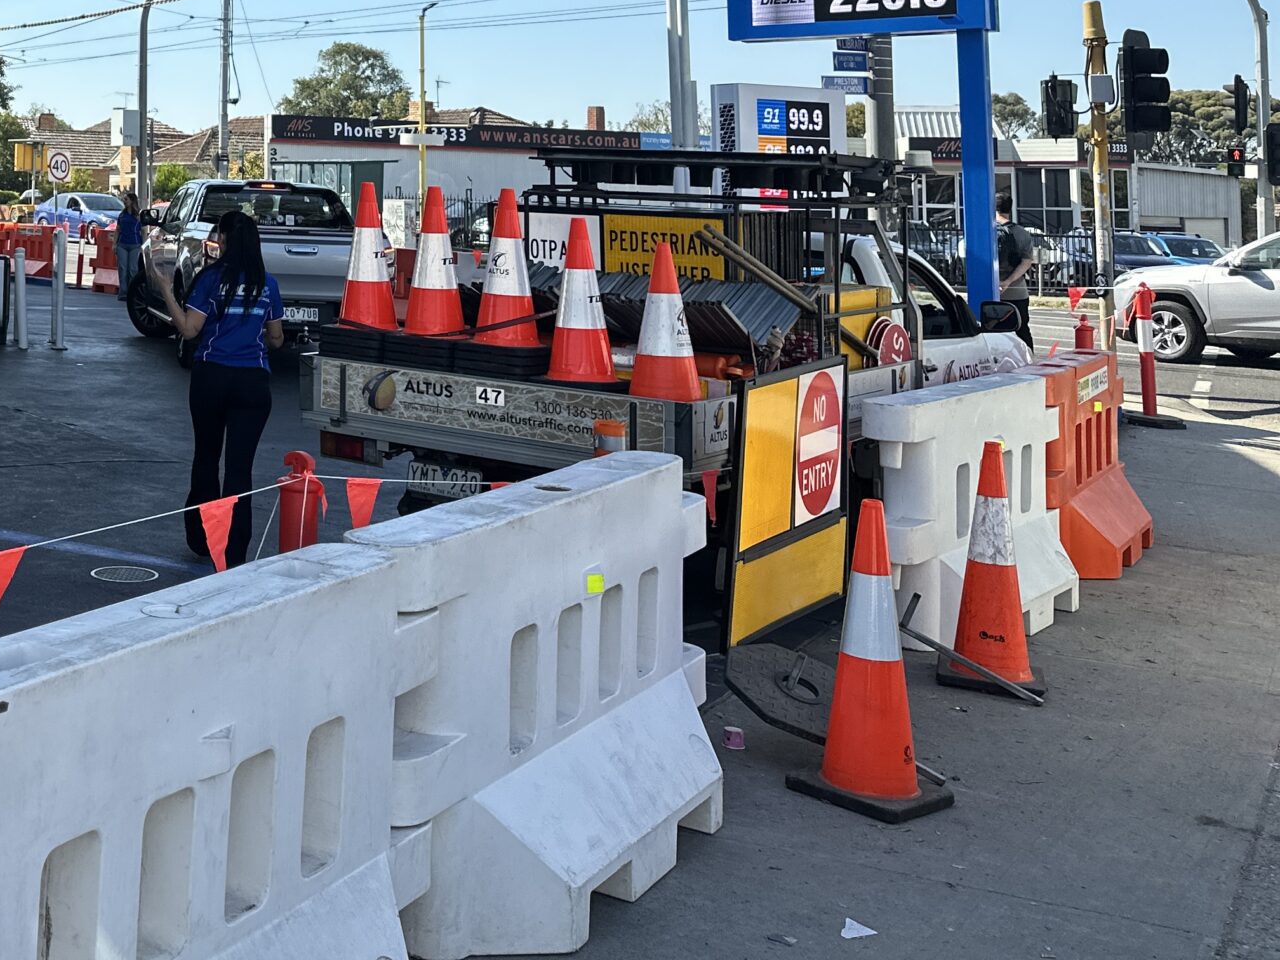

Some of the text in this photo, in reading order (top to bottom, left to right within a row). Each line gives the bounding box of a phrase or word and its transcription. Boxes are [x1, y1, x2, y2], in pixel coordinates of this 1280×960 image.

[833, 78, 858, 86] PRESTON
[287, 119, 312, 131] ANS
[764, 108, 823, 131] 91 99.9
[333, 122, 383, 138] Phone
[480, 129, 639, 149] www.anscars.com.au
[1112, 144, 1128, 153] 3333
[52, 159, 67, 173] 40
[488, 268, 510, 276] ALTUS
[302, 308, 318, 320] 7UB
[959, 363, 980, 381] ALTUS
[404, 380, 502, 405] ALTUS 47
[534, 400, 613, 421] 1300 136 530
[813, 395, 827, 424] NO
[467, 409, 593, 436] www.altustraffic.com
[710, 429, 727, 444] ALTUS
[411, 464, 478, 495] YMT 920
[802, 459, 834, 496] ENTRY
